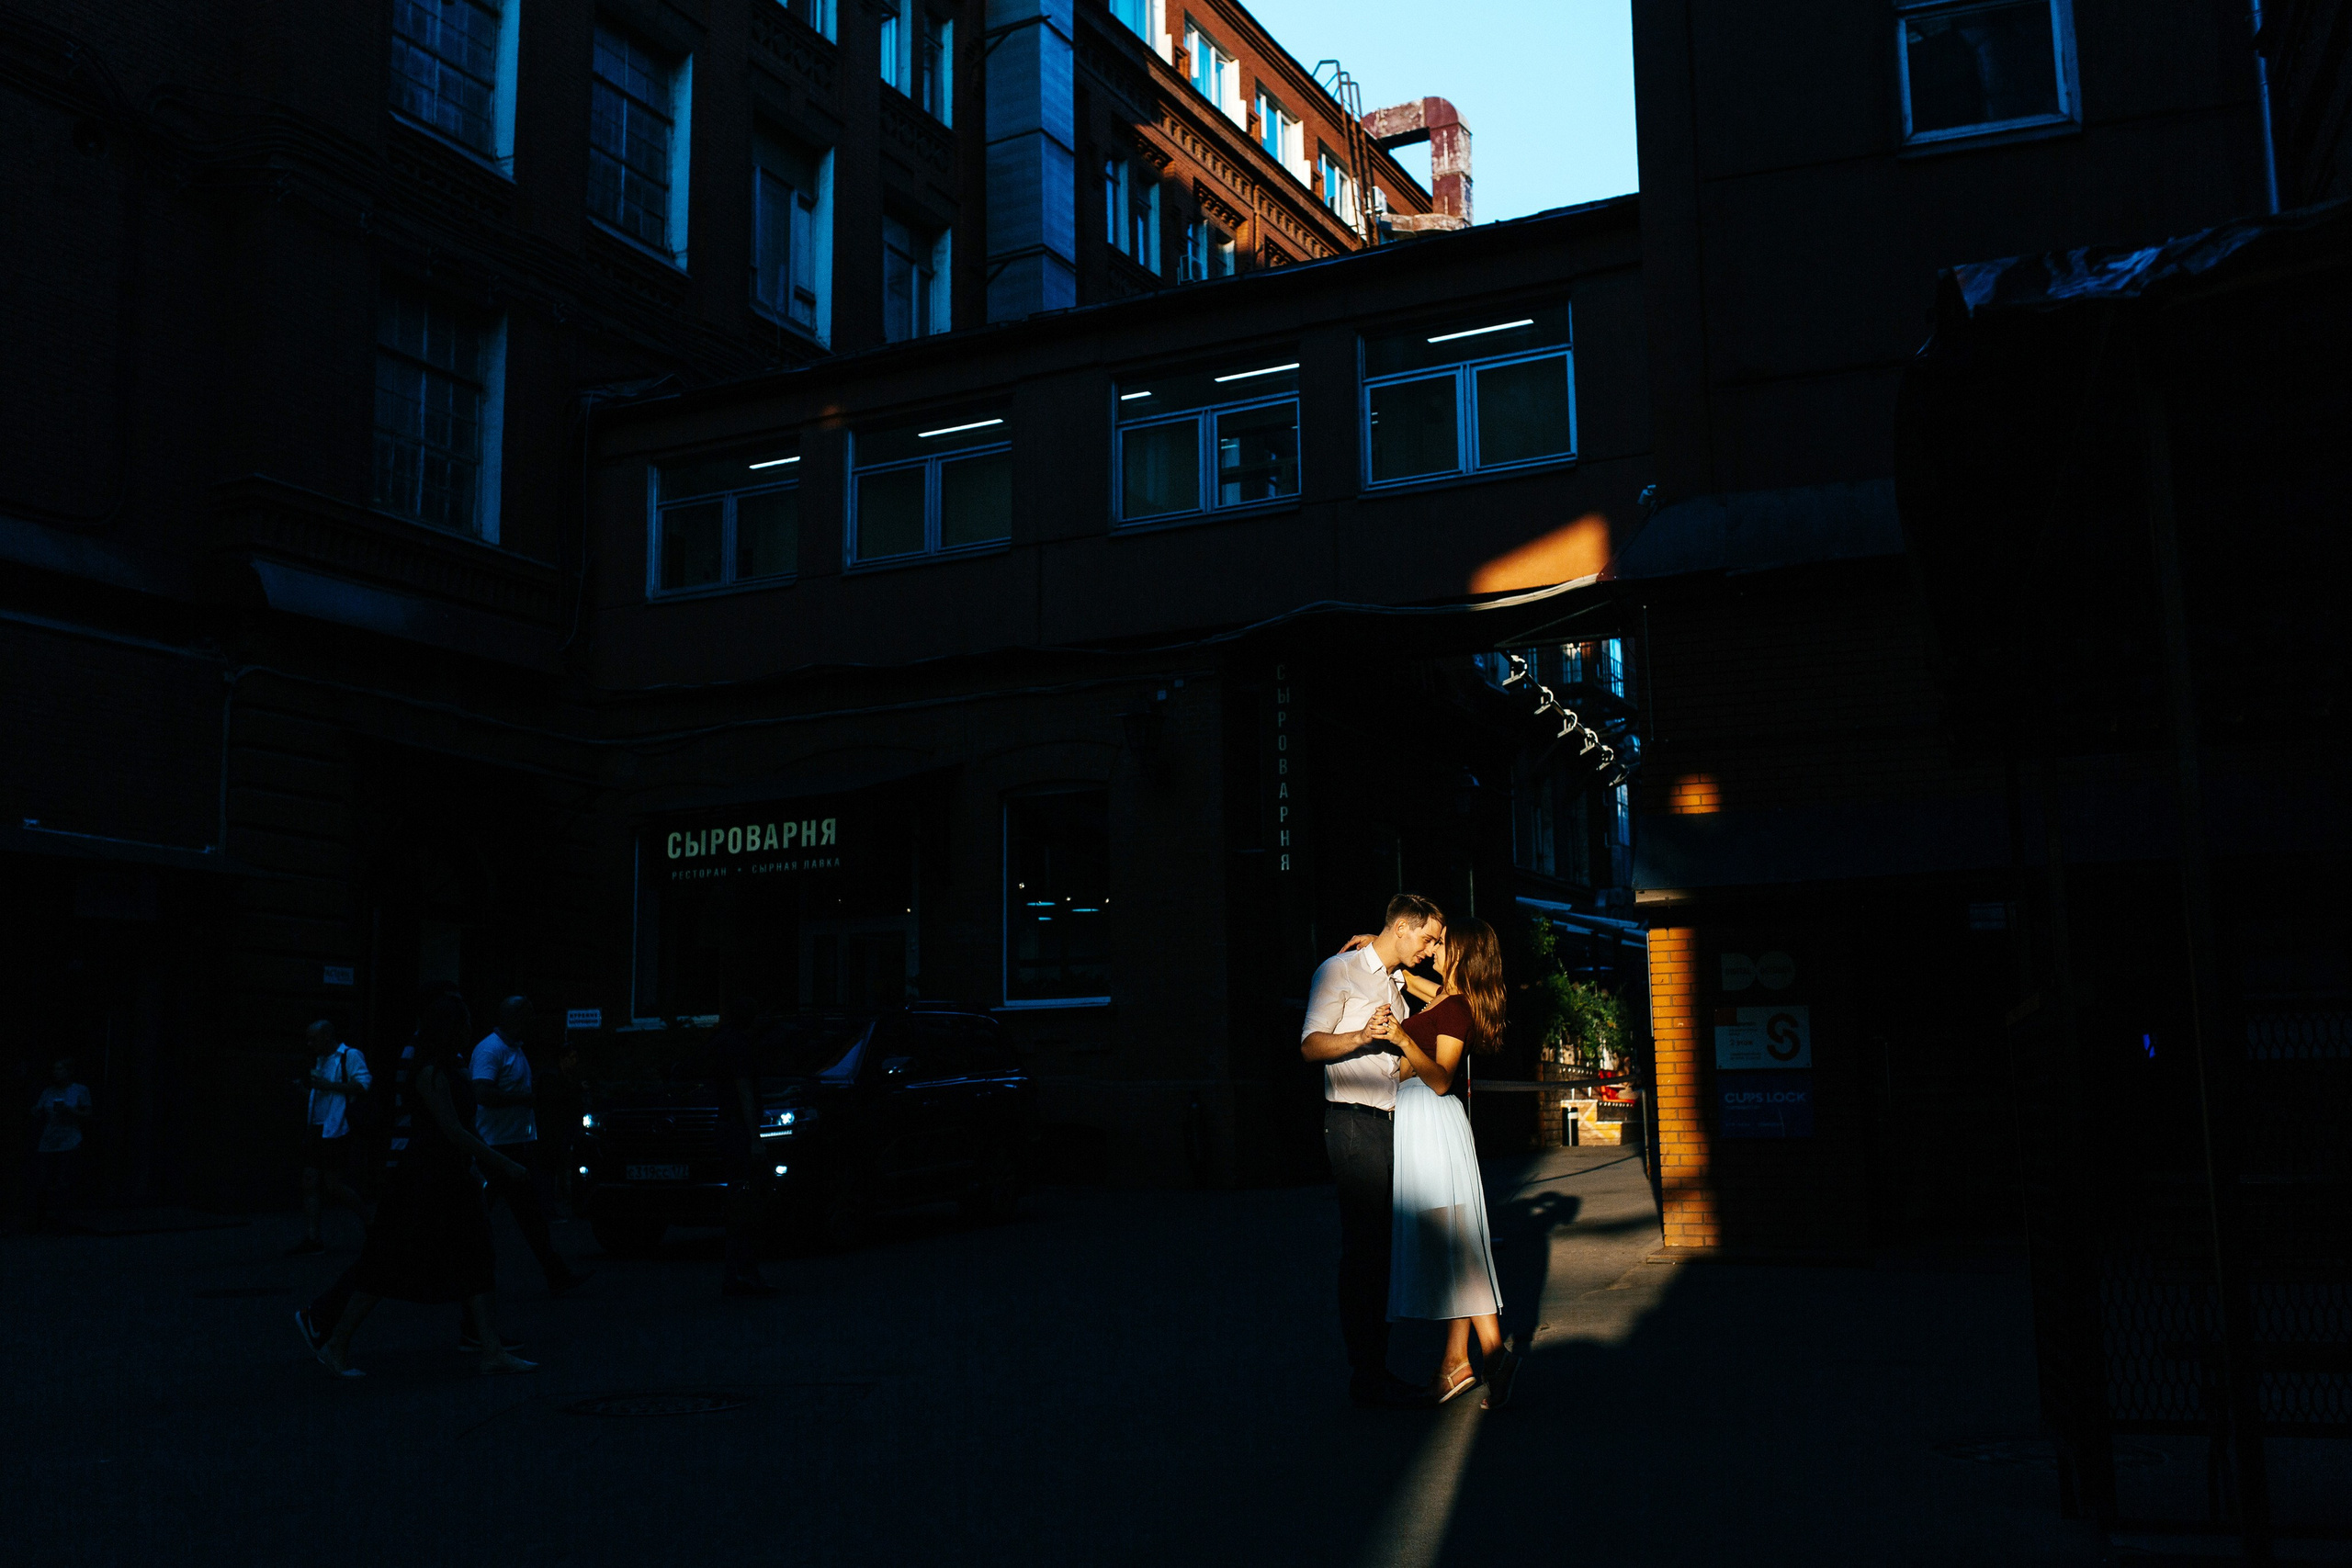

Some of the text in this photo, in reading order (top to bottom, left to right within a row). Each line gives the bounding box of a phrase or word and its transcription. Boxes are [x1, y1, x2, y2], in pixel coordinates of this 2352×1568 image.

[1276, 664, 1291, 872] СЫРОВАРНЯ
[667, 818, 837, 860] СЫРОВАРНЯ
[672, 857, 841, 880] РЕСТОРАН СЫРНАЯ ЛАВКА
[1767, 1091, 1806, 1104] LOCK
